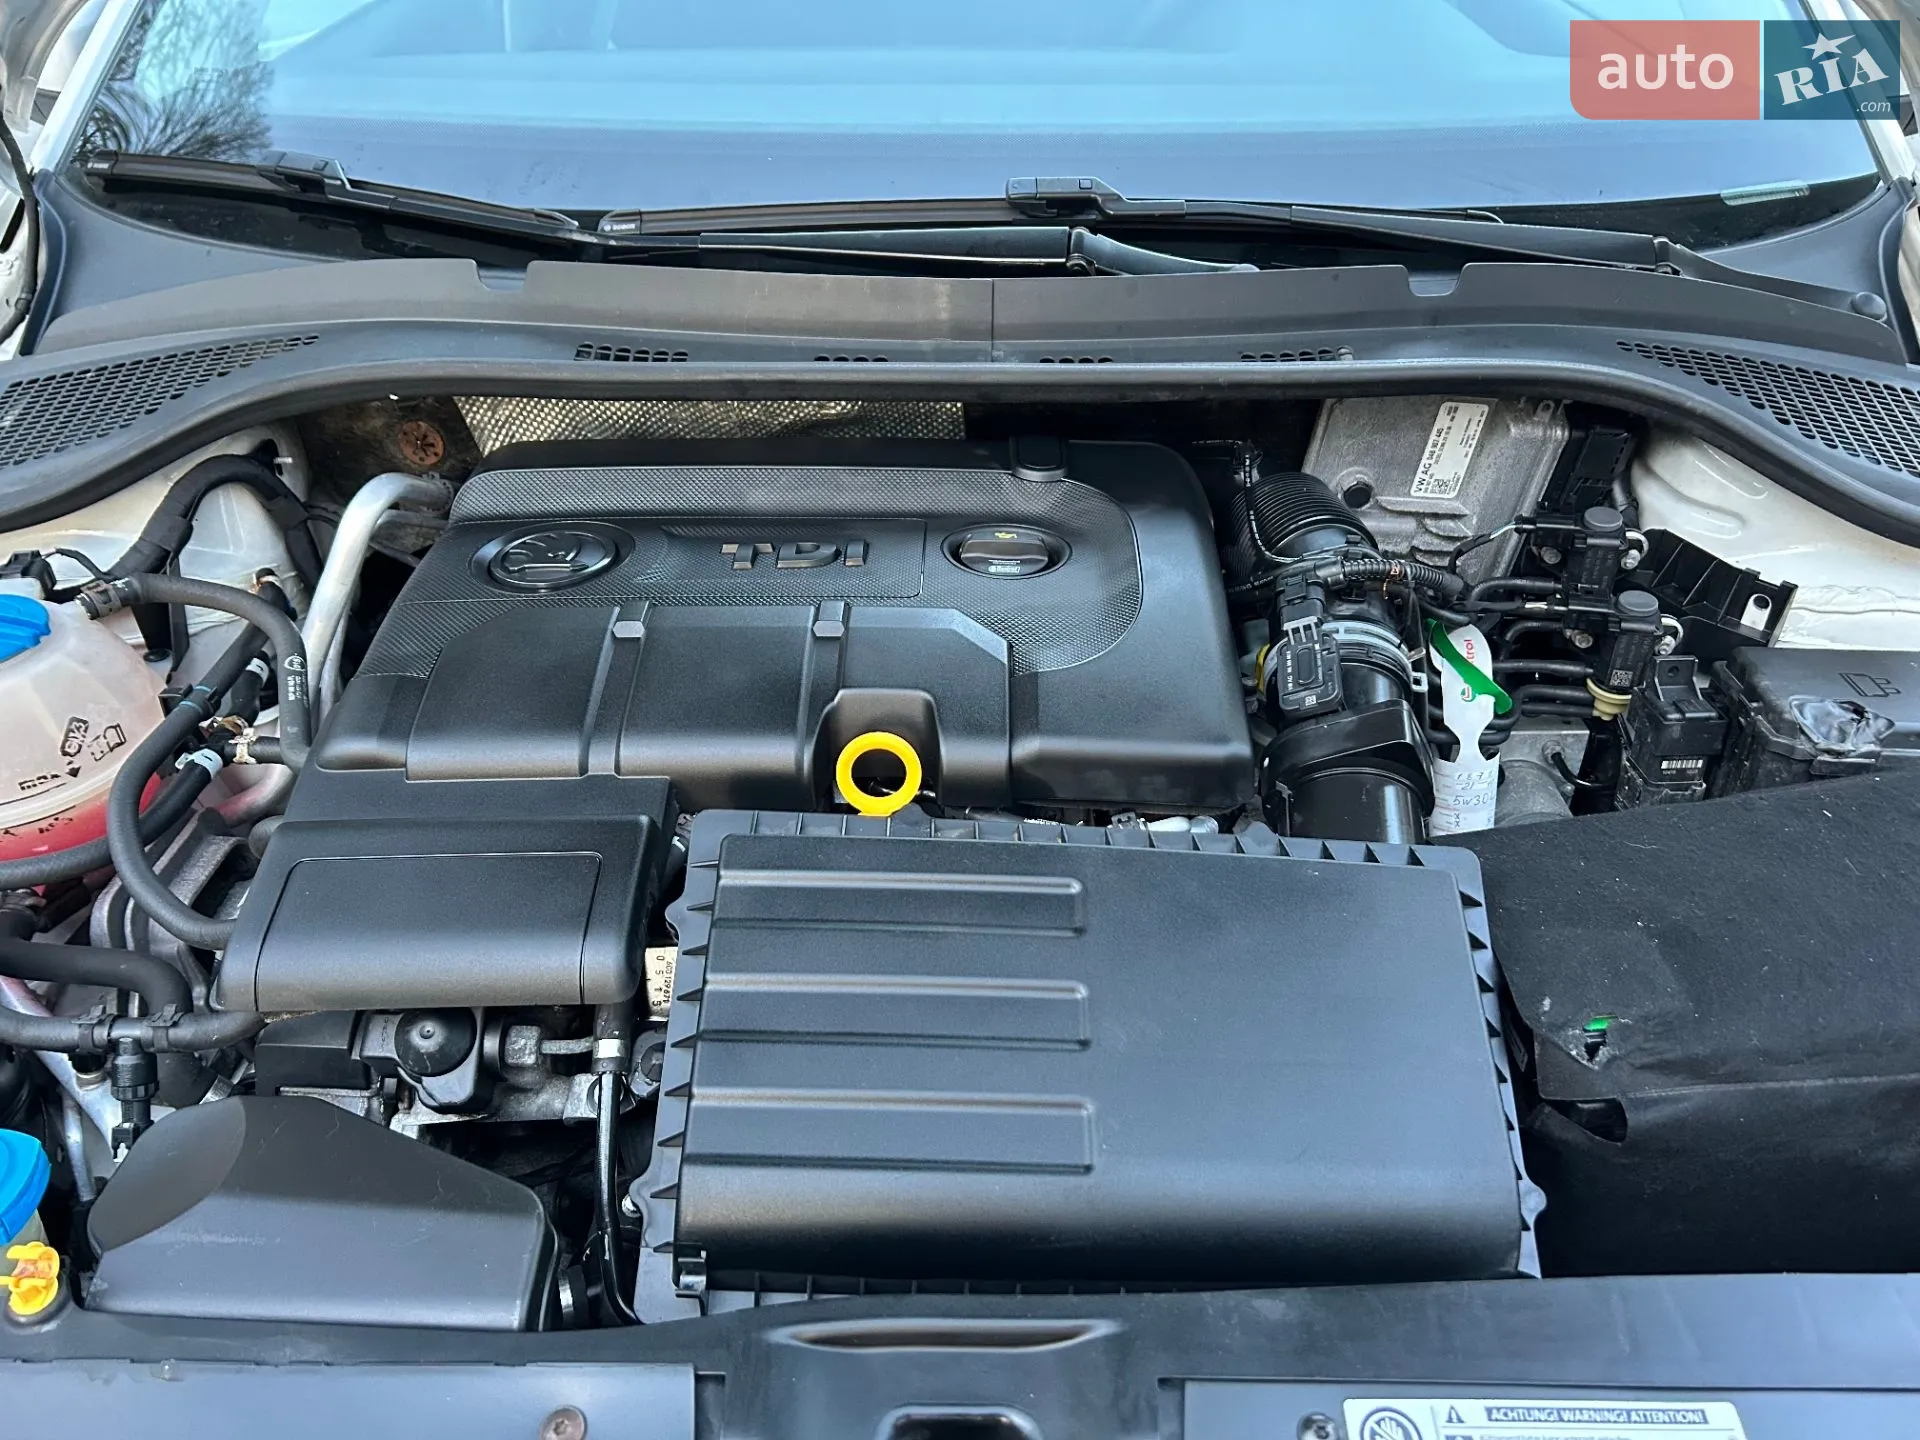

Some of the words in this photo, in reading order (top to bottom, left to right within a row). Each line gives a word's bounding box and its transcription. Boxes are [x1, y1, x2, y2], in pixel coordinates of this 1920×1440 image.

[1414, 477, 1426, 493] VW
[1421, 463, 1432, 476] AG
[720, 539, 870, 570] TDI
[1490, 1408, 1558, 1422] ACHTUNG!
[1561, 1409, 1628, 1423] WARNING!
[1631, 1410, 1706, 1424] ATTENTION!
